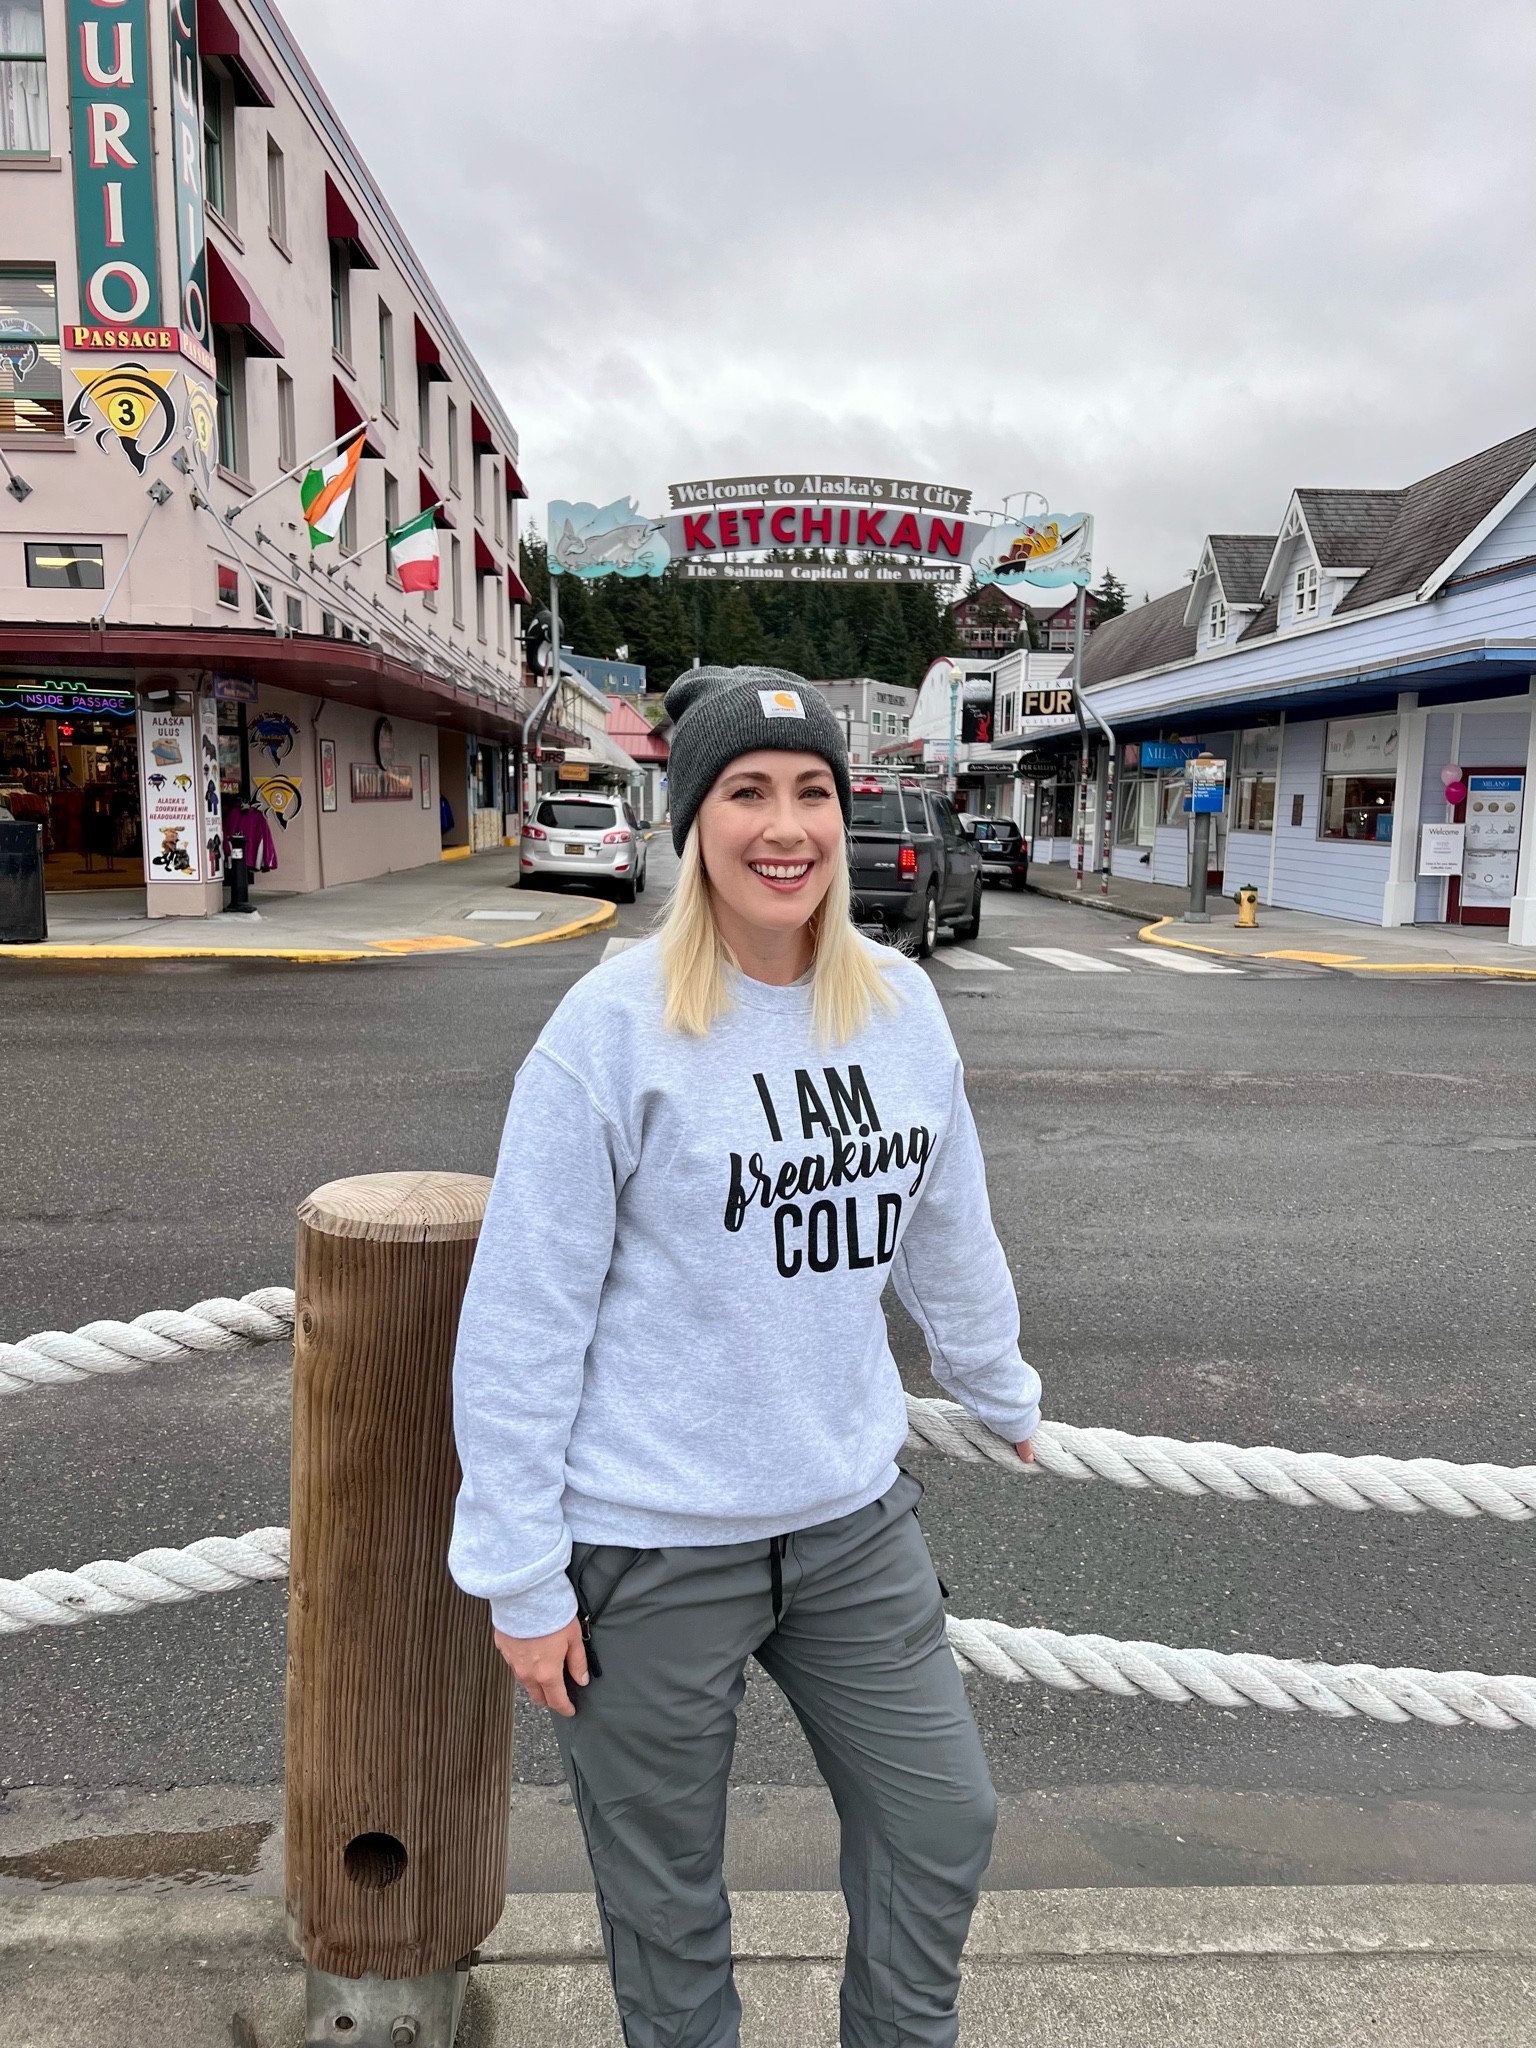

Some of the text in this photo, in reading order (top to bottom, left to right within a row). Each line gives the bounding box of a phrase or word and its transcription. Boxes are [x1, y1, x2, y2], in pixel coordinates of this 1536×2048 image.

[79, 0, 150, 325] URIO
[73, 326, 171, 348] PASSAGE
[182, 332, 215, 374] PASSAGE
[117, 398, 136, 426] 3
[200, 415, 207, 443] 3
[676, 475, 964, 512] Welcome to Alaska's 1st City
[682, 506, 965, 557] KETCHIKAN
[685, 564, 956, 581] The Salmon Capital of the World
[1027, 680, 1073, 690] SITKA
[21, 694, 126, 709] INSIDE PASSAGE
[1024, 690, 1073, 715] FUR
[152, 716, 185, 727] ALASKA
[157, 728, 181, 738] ULUS
[1146, 747, 1201, 761] MILANO
[1483, 780, 1510, 788] MILANO
[157, 797, 186, 805] ALASKA'S
[275, 792, 283, 807] 3
[149, 812, 196, 821] HEADQUARTERS
[1429, 828, 1460, 836] Welcome
[752, 1064, 882, 1142] I AM
[724, 1125, 938, 1233] freaking
[773, 1193, 903, 1279] COLD
